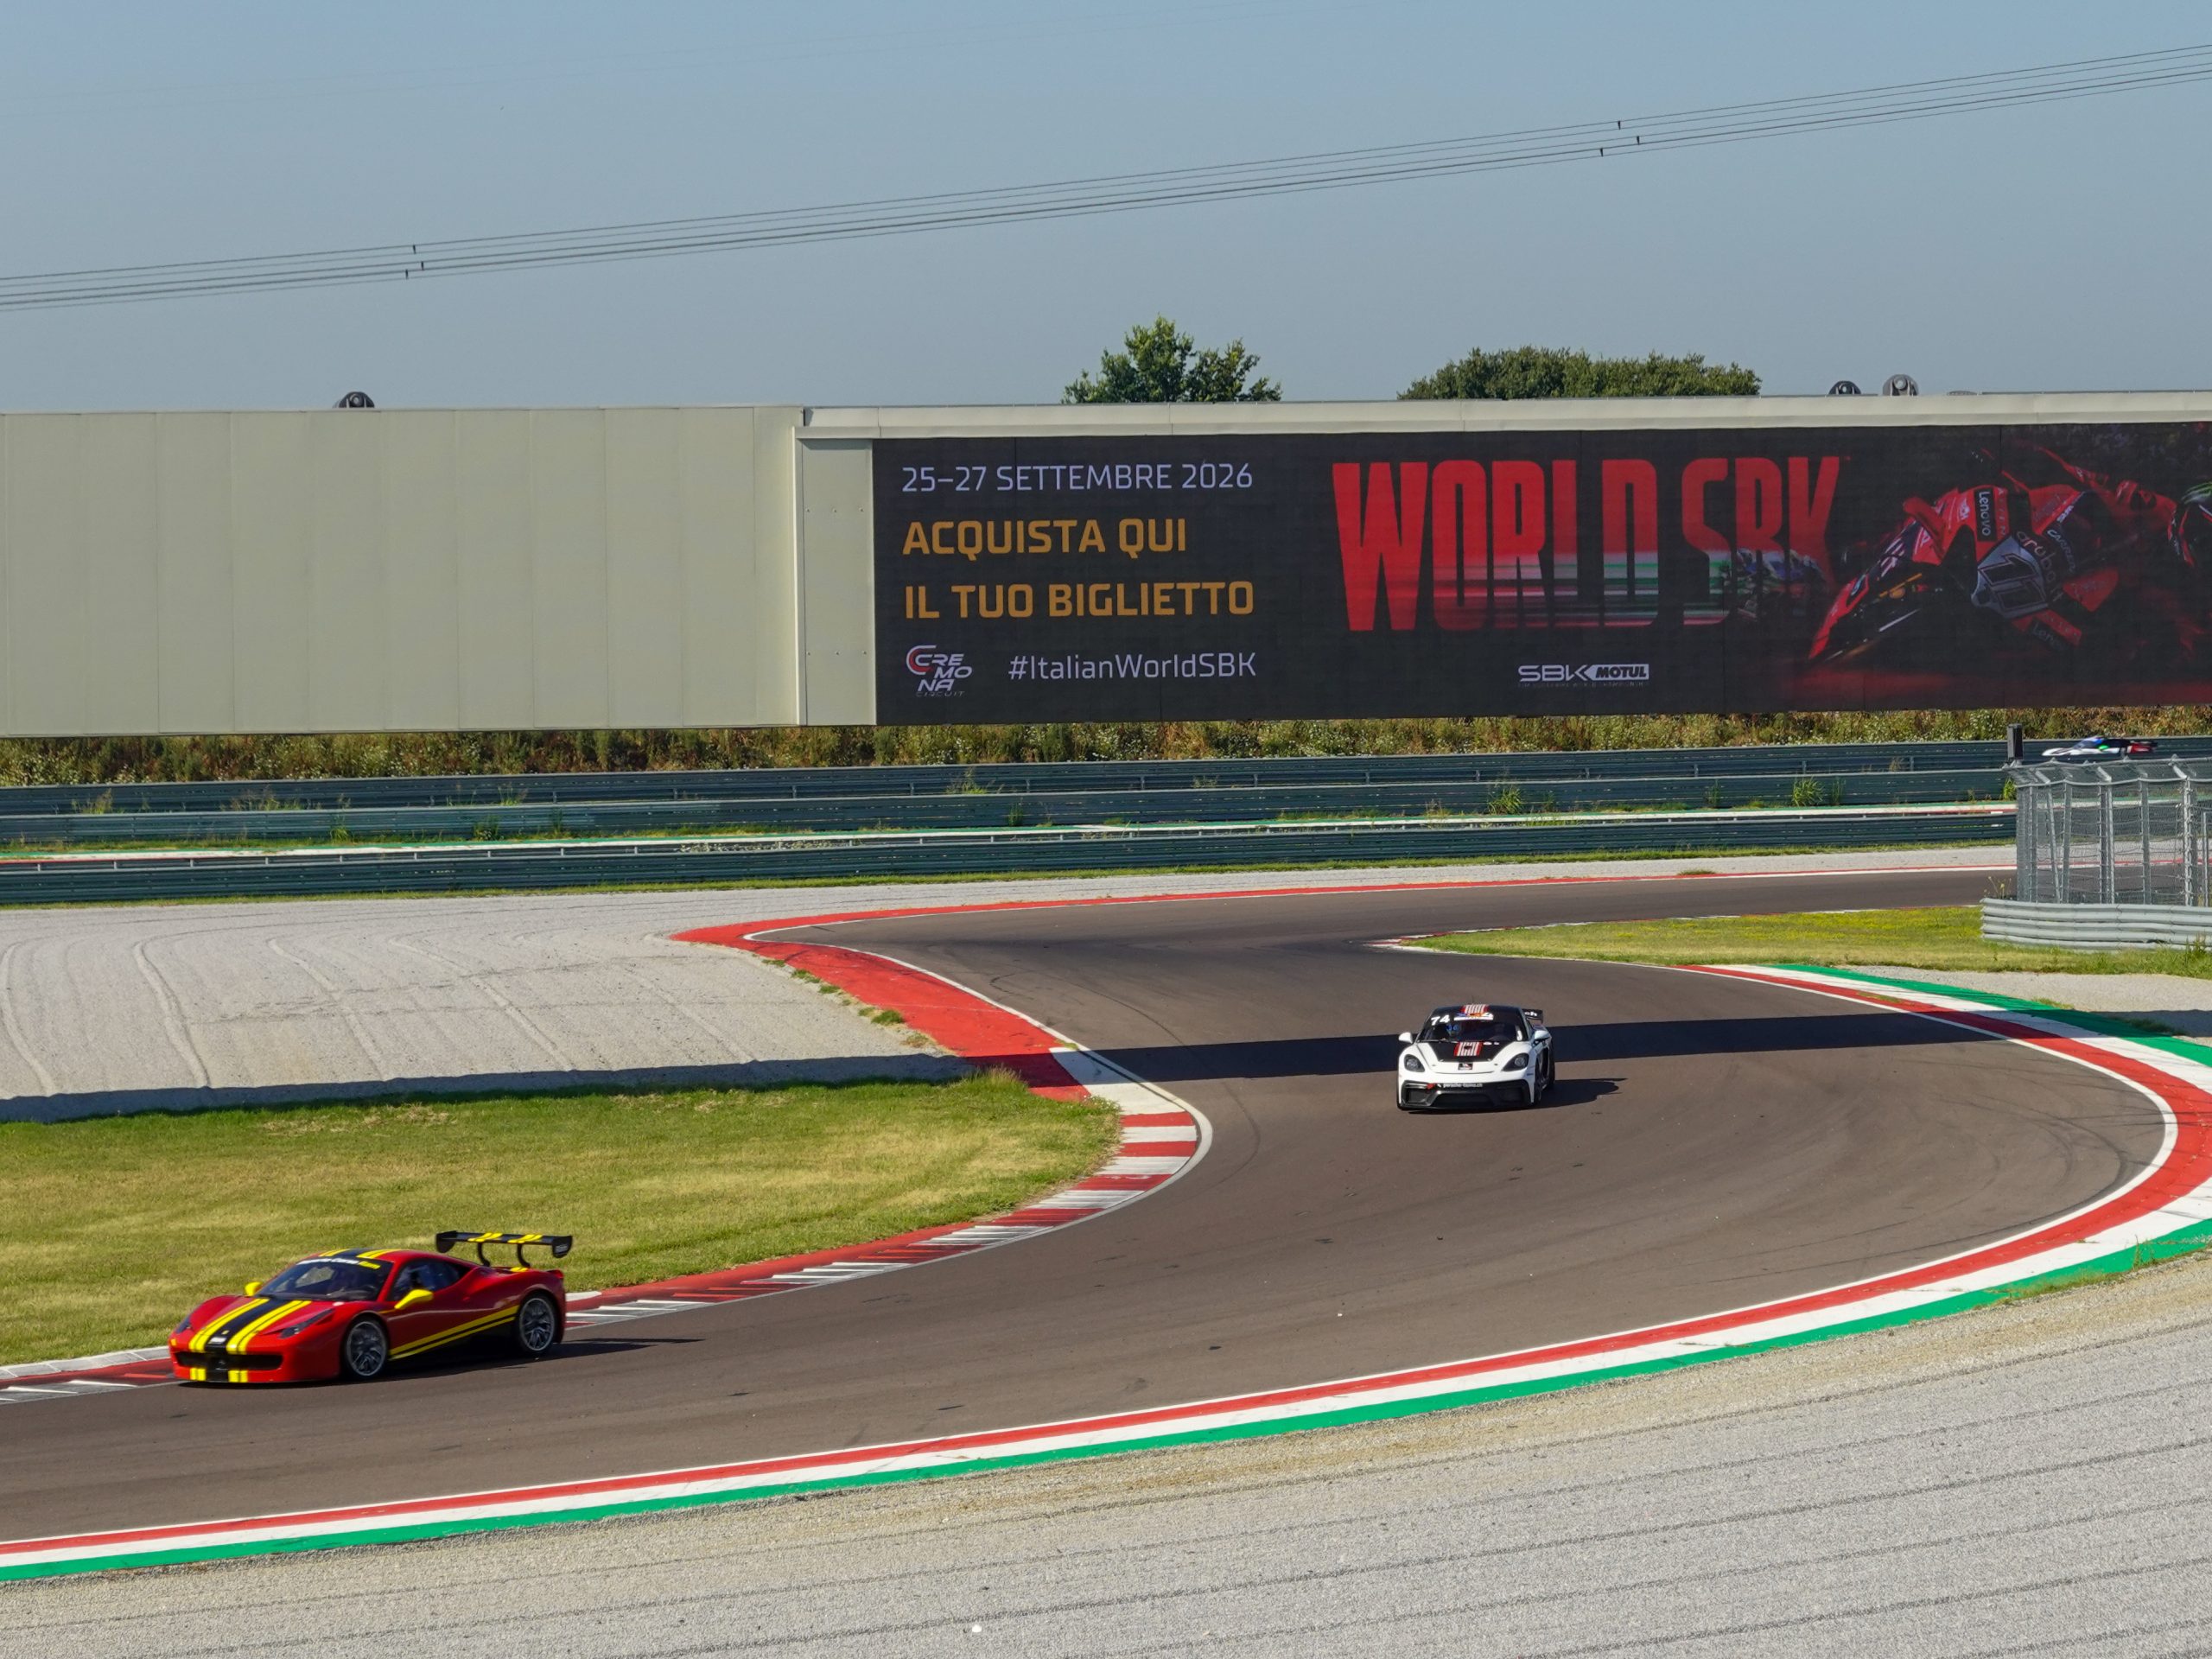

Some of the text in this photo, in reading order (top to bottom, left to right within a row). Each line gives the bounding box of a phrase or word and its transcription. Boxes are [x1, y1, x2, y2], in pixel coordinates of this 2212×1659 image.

[997, 464, 1173, 491] SETTEMBRE
[1182, 462, 1253, 489] 2026
[1978, 490, 1992, 537] Lenovo
[902, 518, 1186, 562] ACQUISTA QUI
[1332, 456, 1840, 632] WORLD SBK
[906, 581, 1255, 620] IL TUO BIGLIETTO
[1007, 652, 1257, 681] #ItalianWorldSBK
[1517, 664, 1647, 682] SBK MOTUL
[1431, 1014, 1451, 1026] 74
